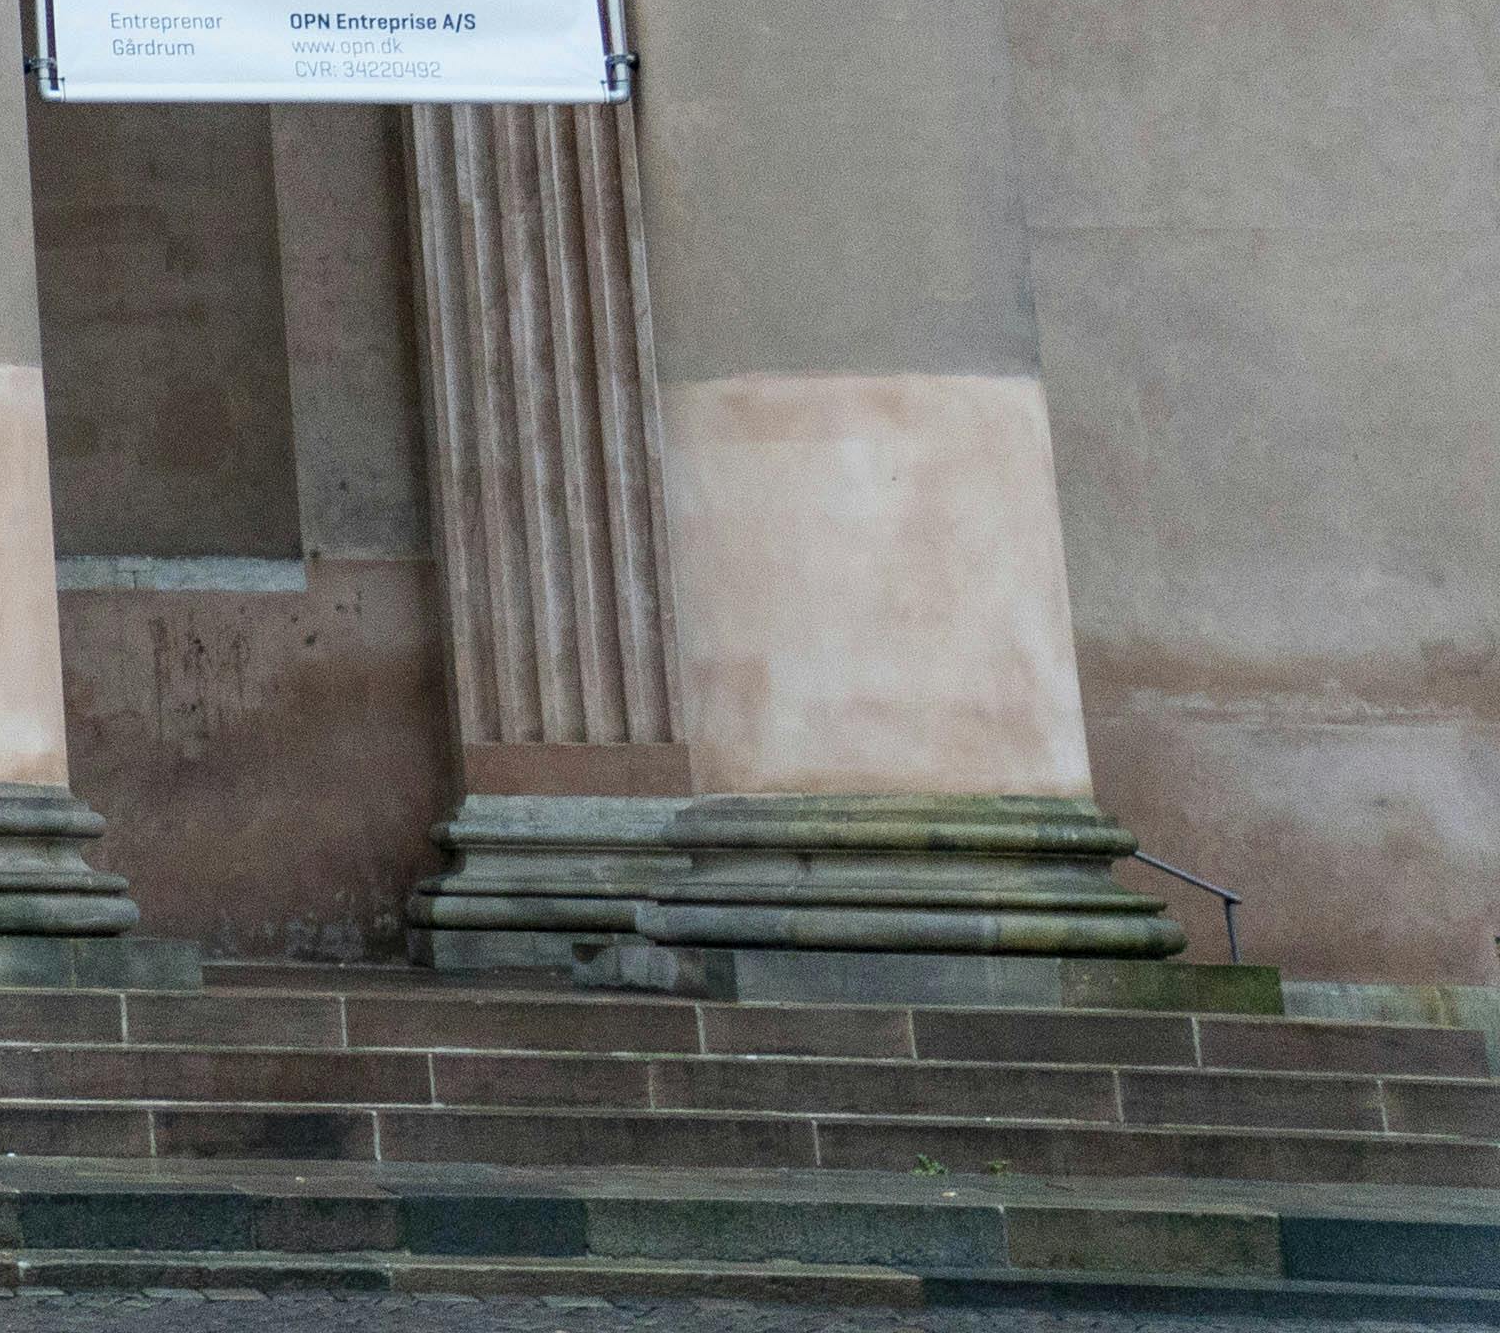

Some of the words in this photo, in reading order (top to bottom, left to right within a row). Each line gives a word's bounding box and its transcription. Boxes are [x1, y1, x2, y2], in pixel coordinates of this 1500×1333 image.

[111, 13, 222, 33] Entreprenør
[290, 13, 330, 29] OPN
[337, 13, 436, 34] Entreprise
[443, 14, 475, 32] A/S
[113, 38, 195, 56] Gårdrum
[292, 37, 402, 57] www.opn.dk
[295, 61, 337, 78] CVR:
[343, 61, 441, 78] 34220492
